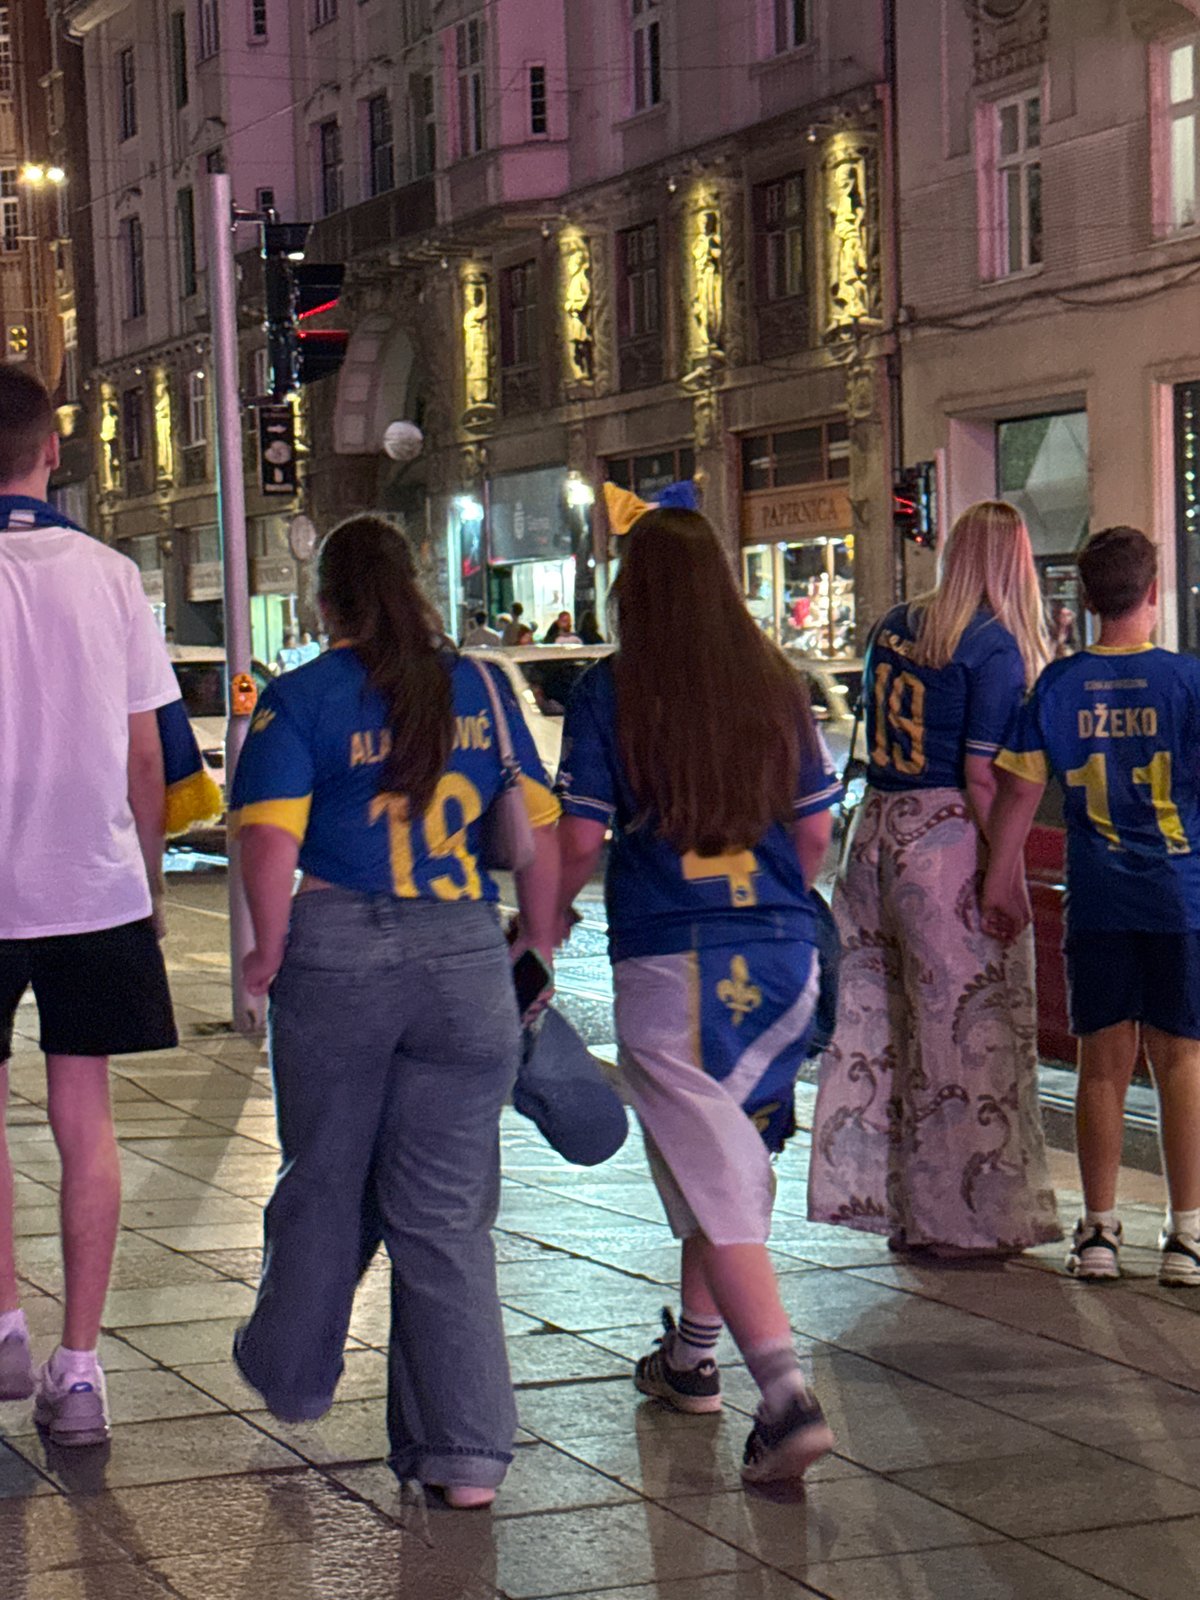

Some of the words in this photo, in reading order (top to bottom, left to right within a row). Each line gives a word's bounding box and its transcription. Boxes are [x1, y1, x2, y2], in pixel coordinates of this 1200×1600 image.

[872, 662, 926, 774] 19
[1077, 702, 1158, 739] DŽEKO
[368, 772, 483, 900] 19
[1066, 752, 1191, 854] 11
